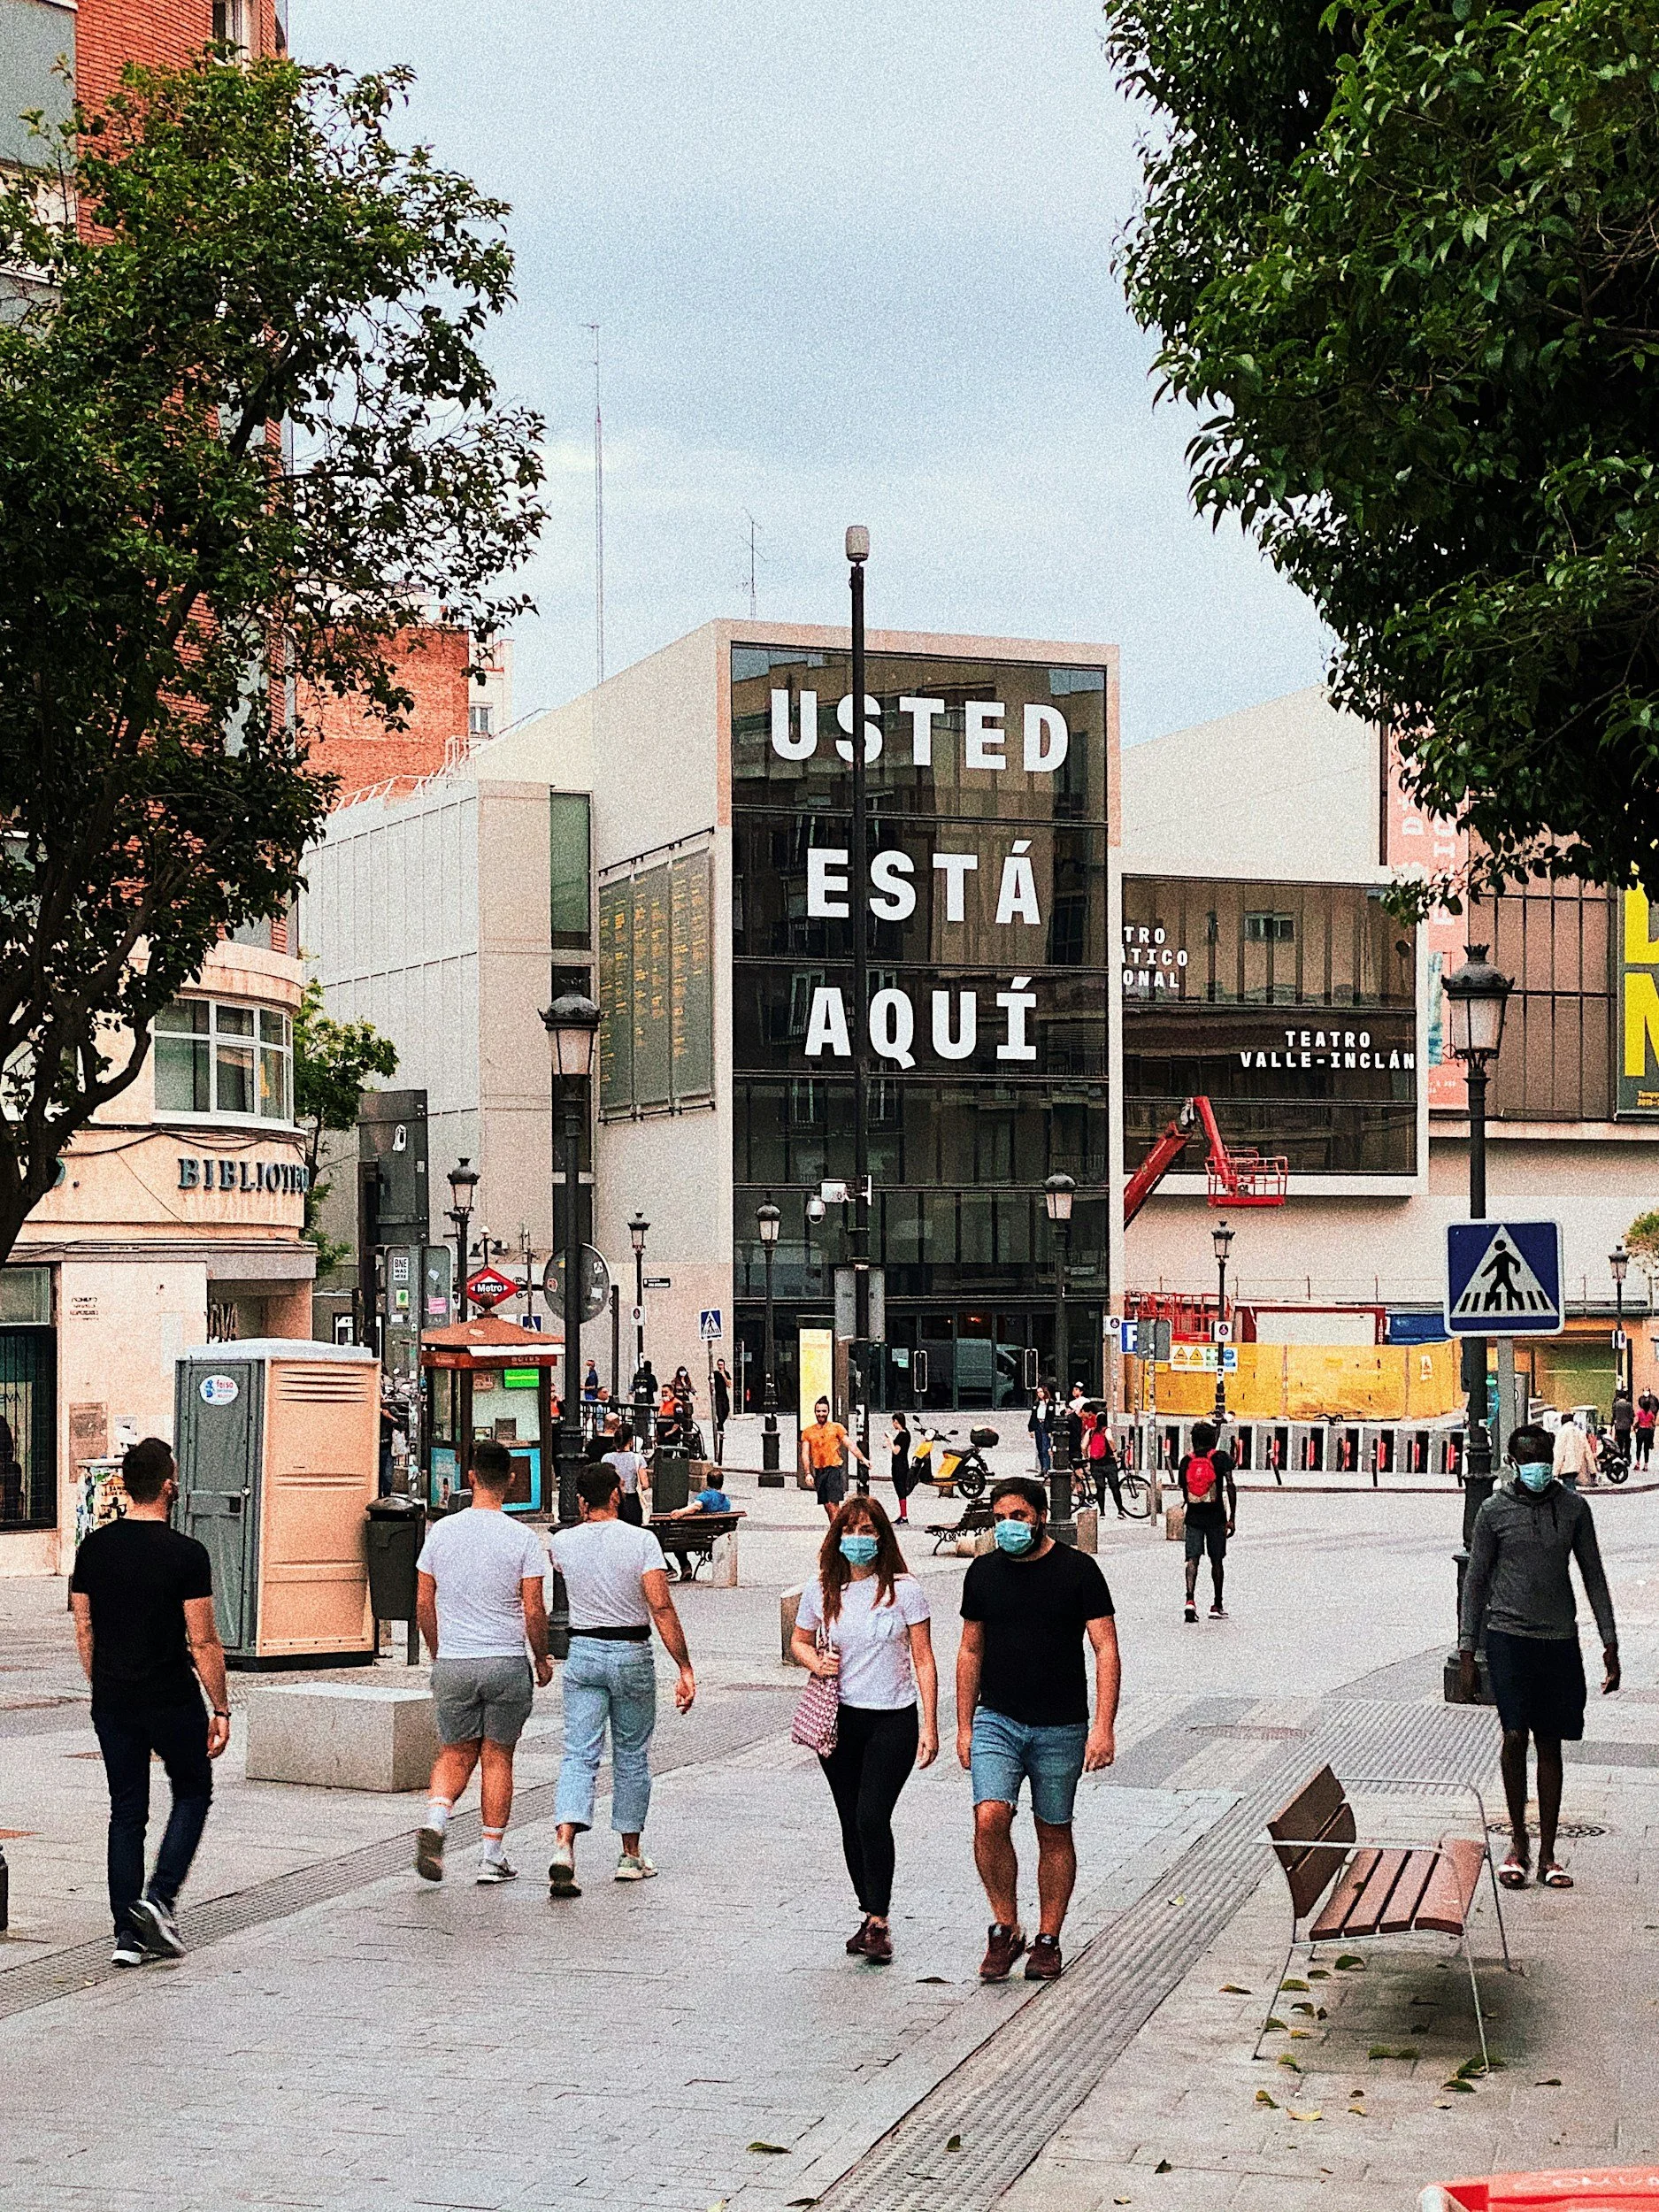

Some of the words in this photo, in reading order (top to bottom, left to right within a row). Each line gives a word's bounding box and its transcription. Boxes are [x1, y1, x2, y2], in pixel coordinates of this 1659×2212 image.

[771, 688, 1069, 772] USTED
[807, 840, 1041, 926] ESTÁ
[804, 977, 1037, 1070] AQUÍ
[1285, 1031, 1371, 1048] TEATRO
[1240, 1049, 1415, 1069] VALLE-INCLÁN
[395, 1258, 407, 1268] BNE
[477, 1284, 503, 1293] Metro
